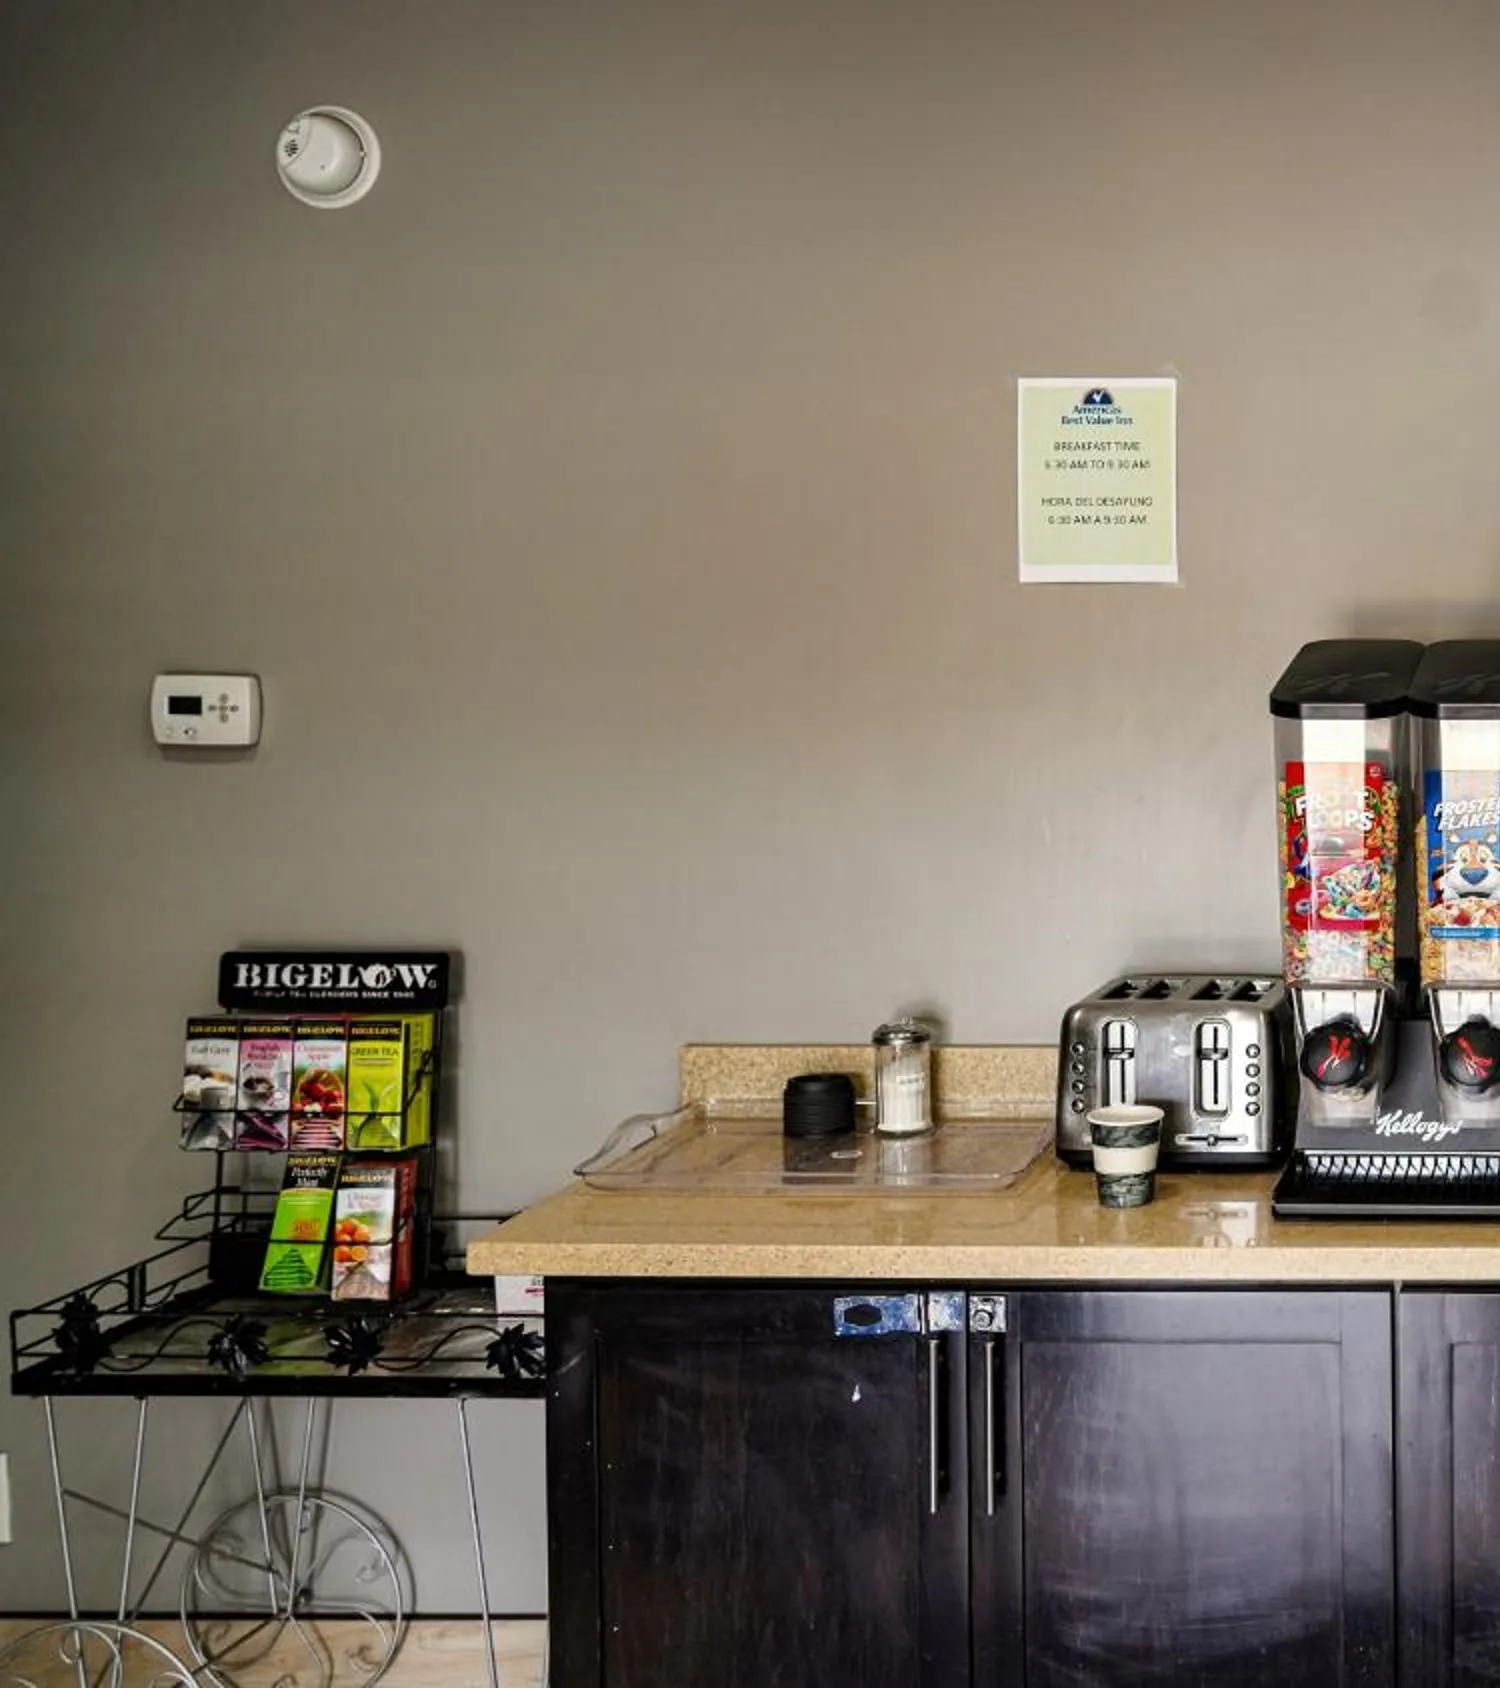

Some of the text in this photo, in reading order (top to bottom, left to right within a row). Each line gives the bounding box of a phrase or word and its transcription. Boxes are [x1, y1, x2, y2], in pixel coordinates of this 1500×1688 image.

[1061, 415, 1133, 425] Best Value Inn
[1053, 441, 1141, 451] BREAKFAST TIME
[1069, 460, 1088, 469] AM
[1090, 460, 1105, 469] TO
[1131, 460, 1151, 469] AM
[1041, 497, 1153, 507] HORA DEL DESAYUNO
[1073, 515, 1093, 525] AM
[1129, 515, 1148, 525] AM
[233, 962, 438, 989] BIGELOW
